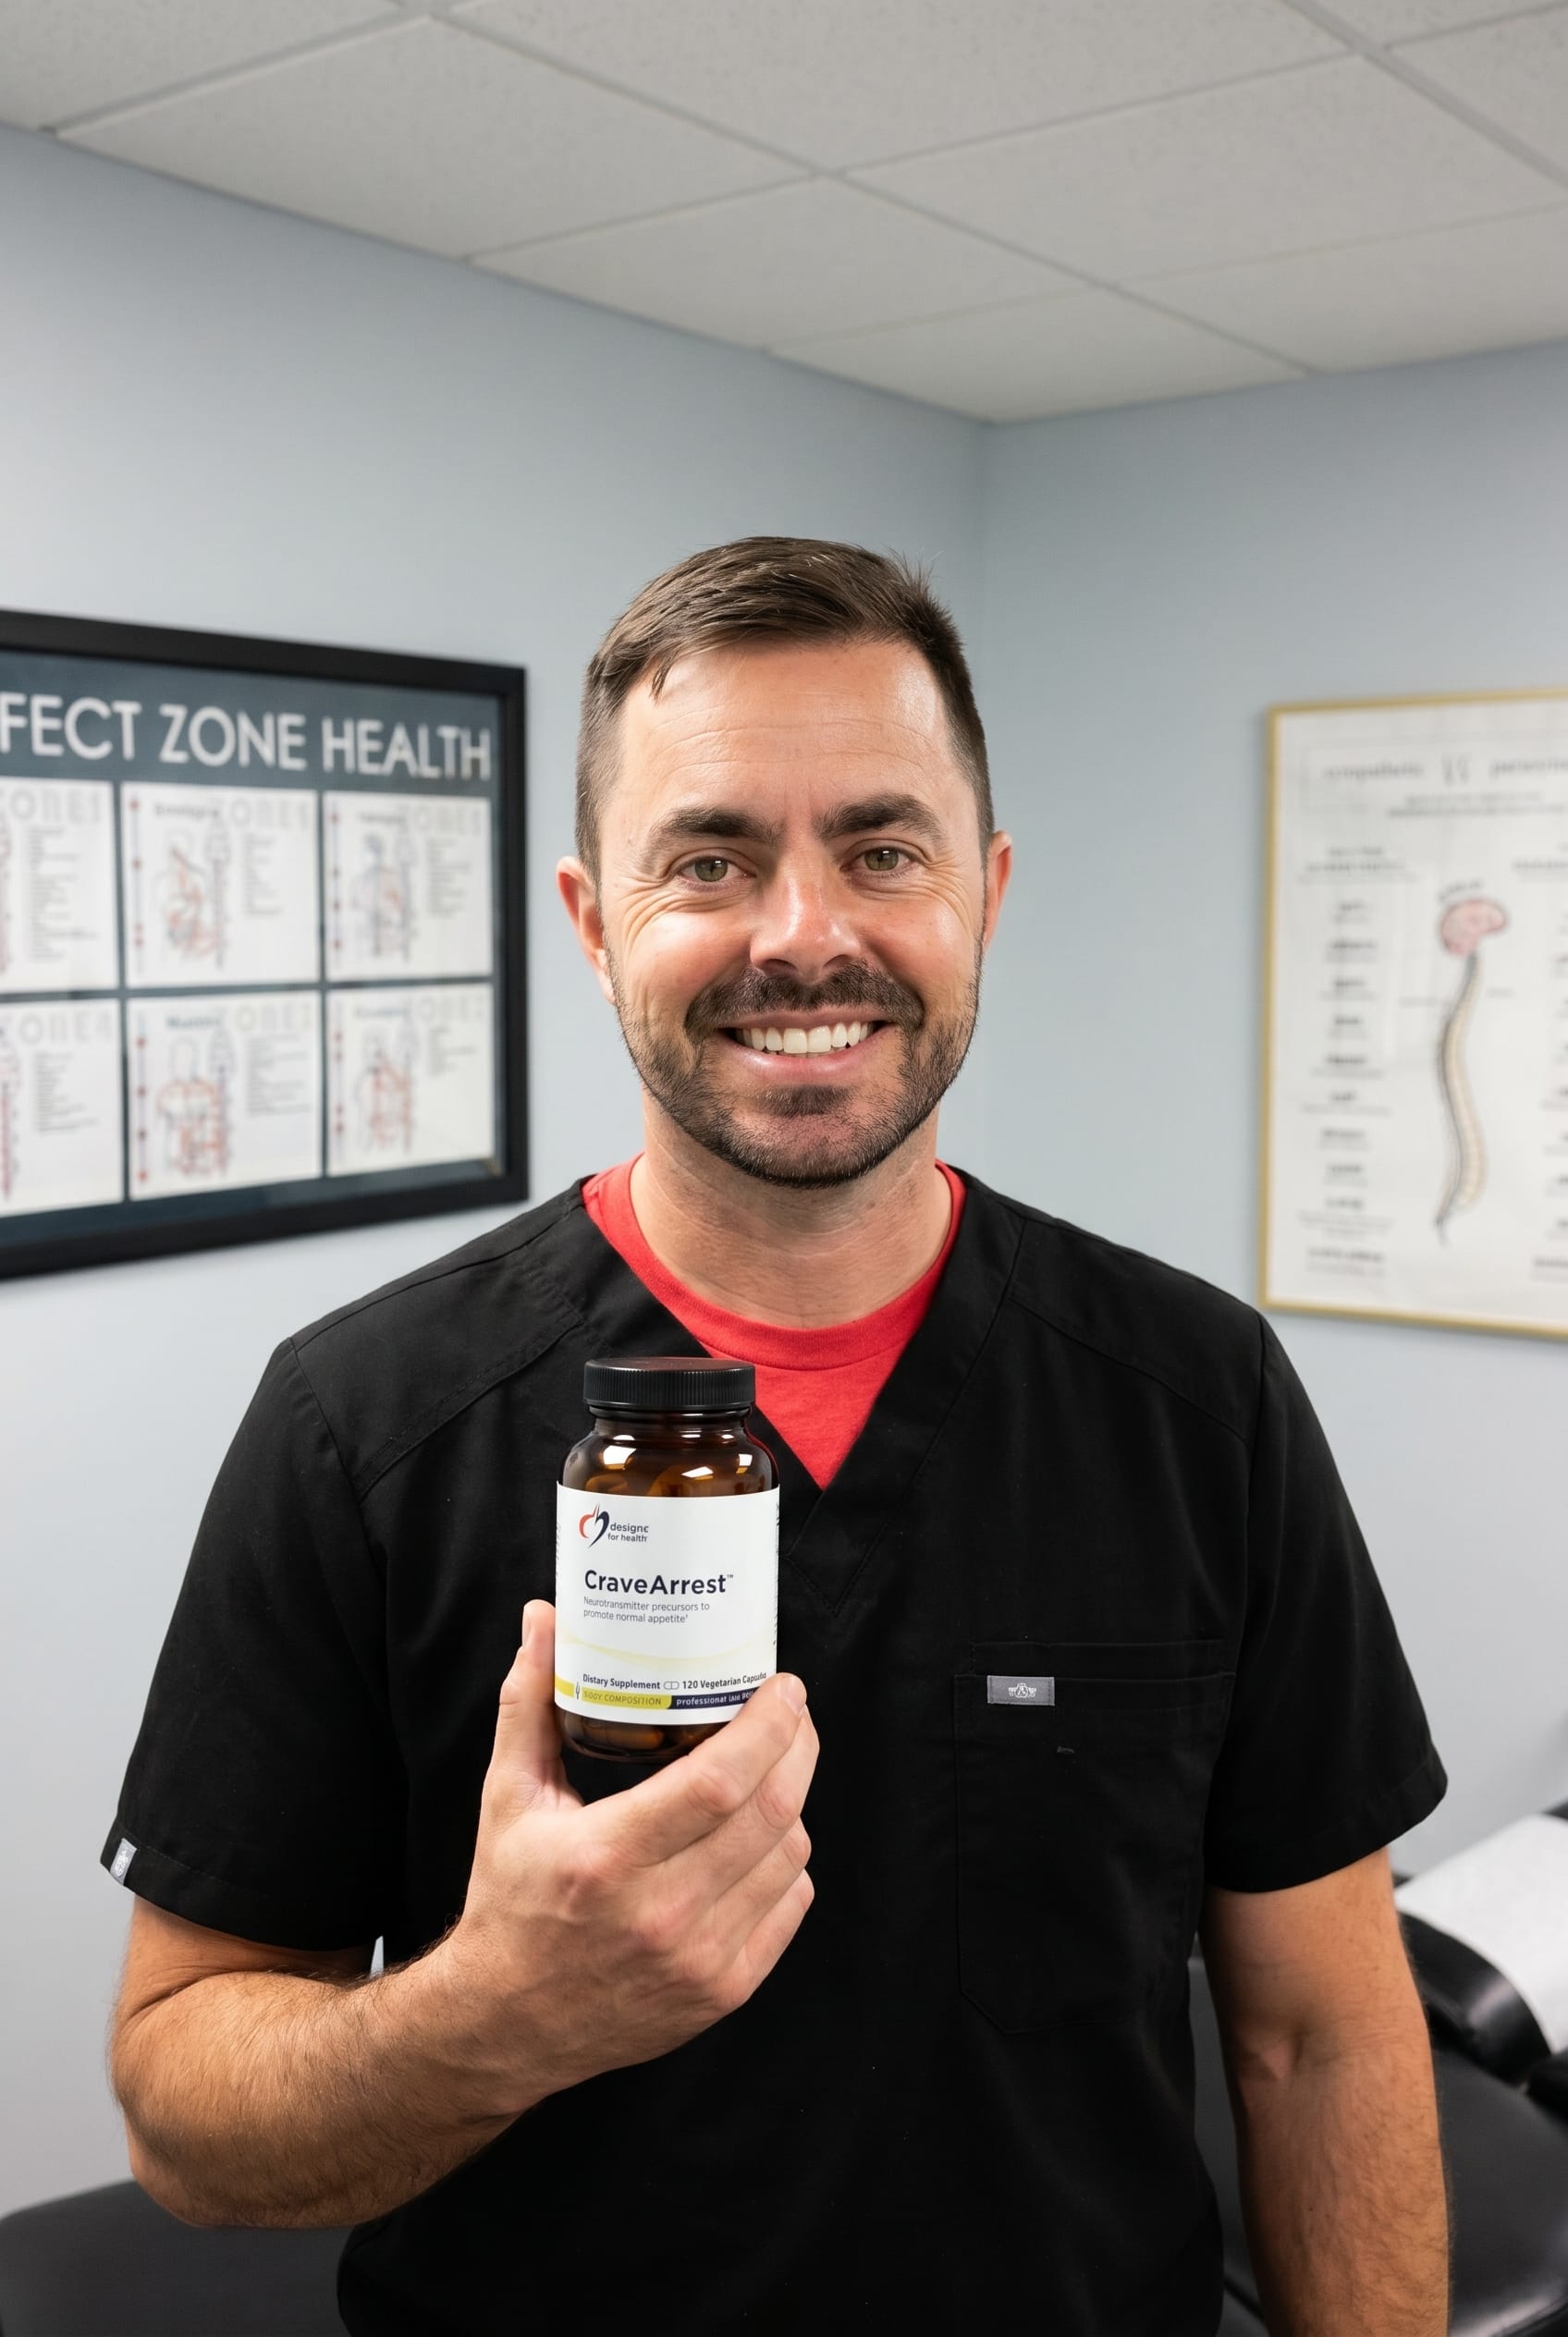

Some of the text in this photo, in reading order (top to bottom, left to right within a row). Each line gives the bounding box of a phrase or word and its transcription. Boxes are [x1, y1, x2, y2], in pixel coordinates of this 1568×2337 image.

[0, 691, 492, 780] FECT ZONE HEALTH
[607, 1533, 619, 1541] for
[583, 1596, 710, 1612] Neurotransmitter precursors to
[583, 1609, 614, 1621] promote
[616, 1613, 645, 1622] normal
[609, 1678, 660, 1690] Supplement
[683, 1681, 698, 1690] 120
[700, 1677, 741, 1690] Vegetarian
[604, 1694, 662, 1706] COMPOSITION
